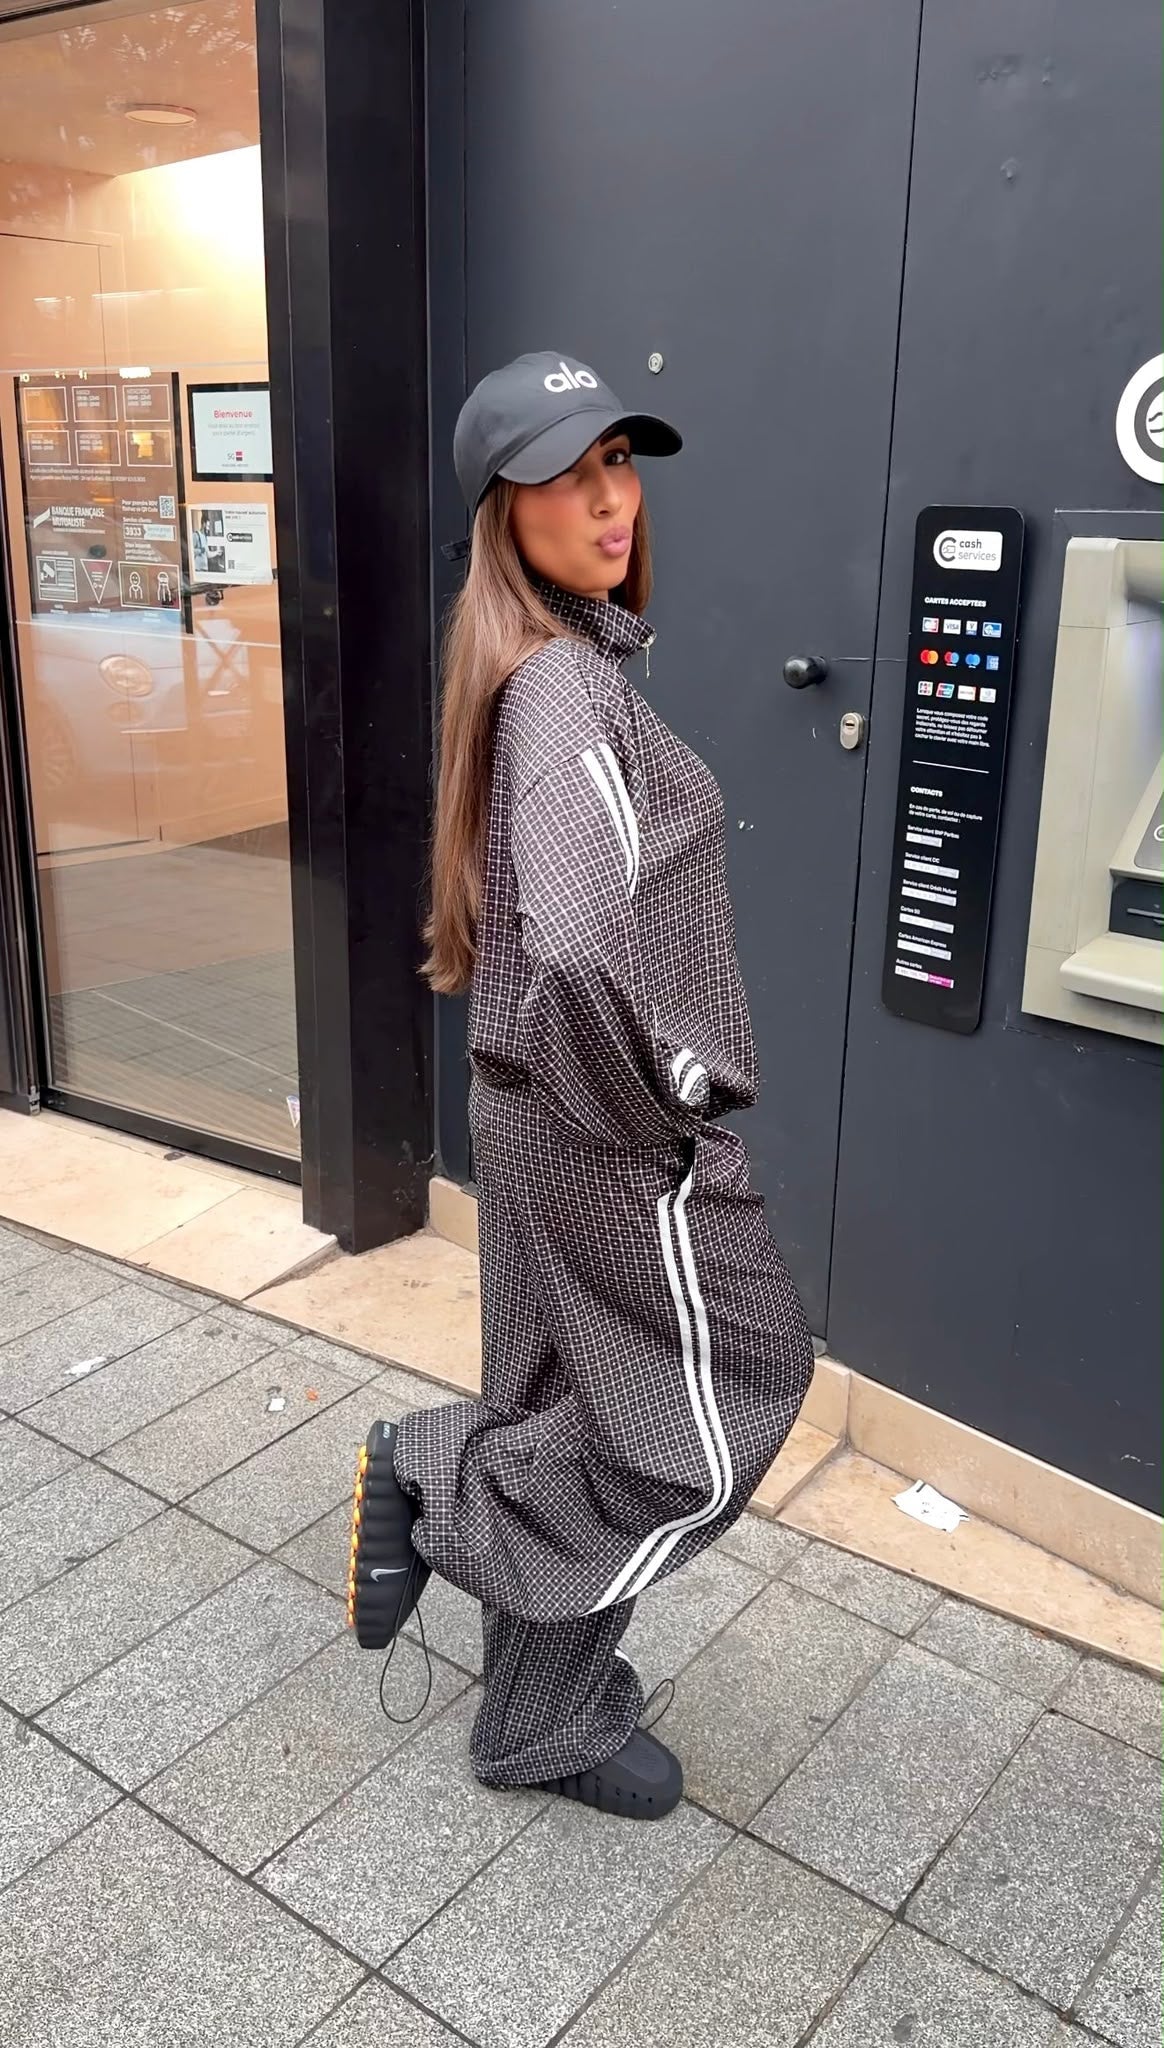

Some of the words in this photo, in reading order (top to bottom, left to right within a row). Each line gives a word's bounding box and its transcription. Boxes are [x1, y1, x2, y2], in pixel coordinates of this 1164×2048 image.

[544, 362, 597, 392] alo
[214, 410, 252, 418] Bienvenue
[51, 506, 74, 516] BANQUE
[75, 507, 104, 519] FRANÇAISE
[52, 516, 85, 527] MUTUALISTE
[126, 526, 141, 536] 3933
[960, 539, 982, 549] cash
[958, 551, 996, 561] services
[924, 597, 949, 605] CARTES
[950, 599, 986, 607] ACCEPTEES
[910, 786, 943, 797] CONTACTS
